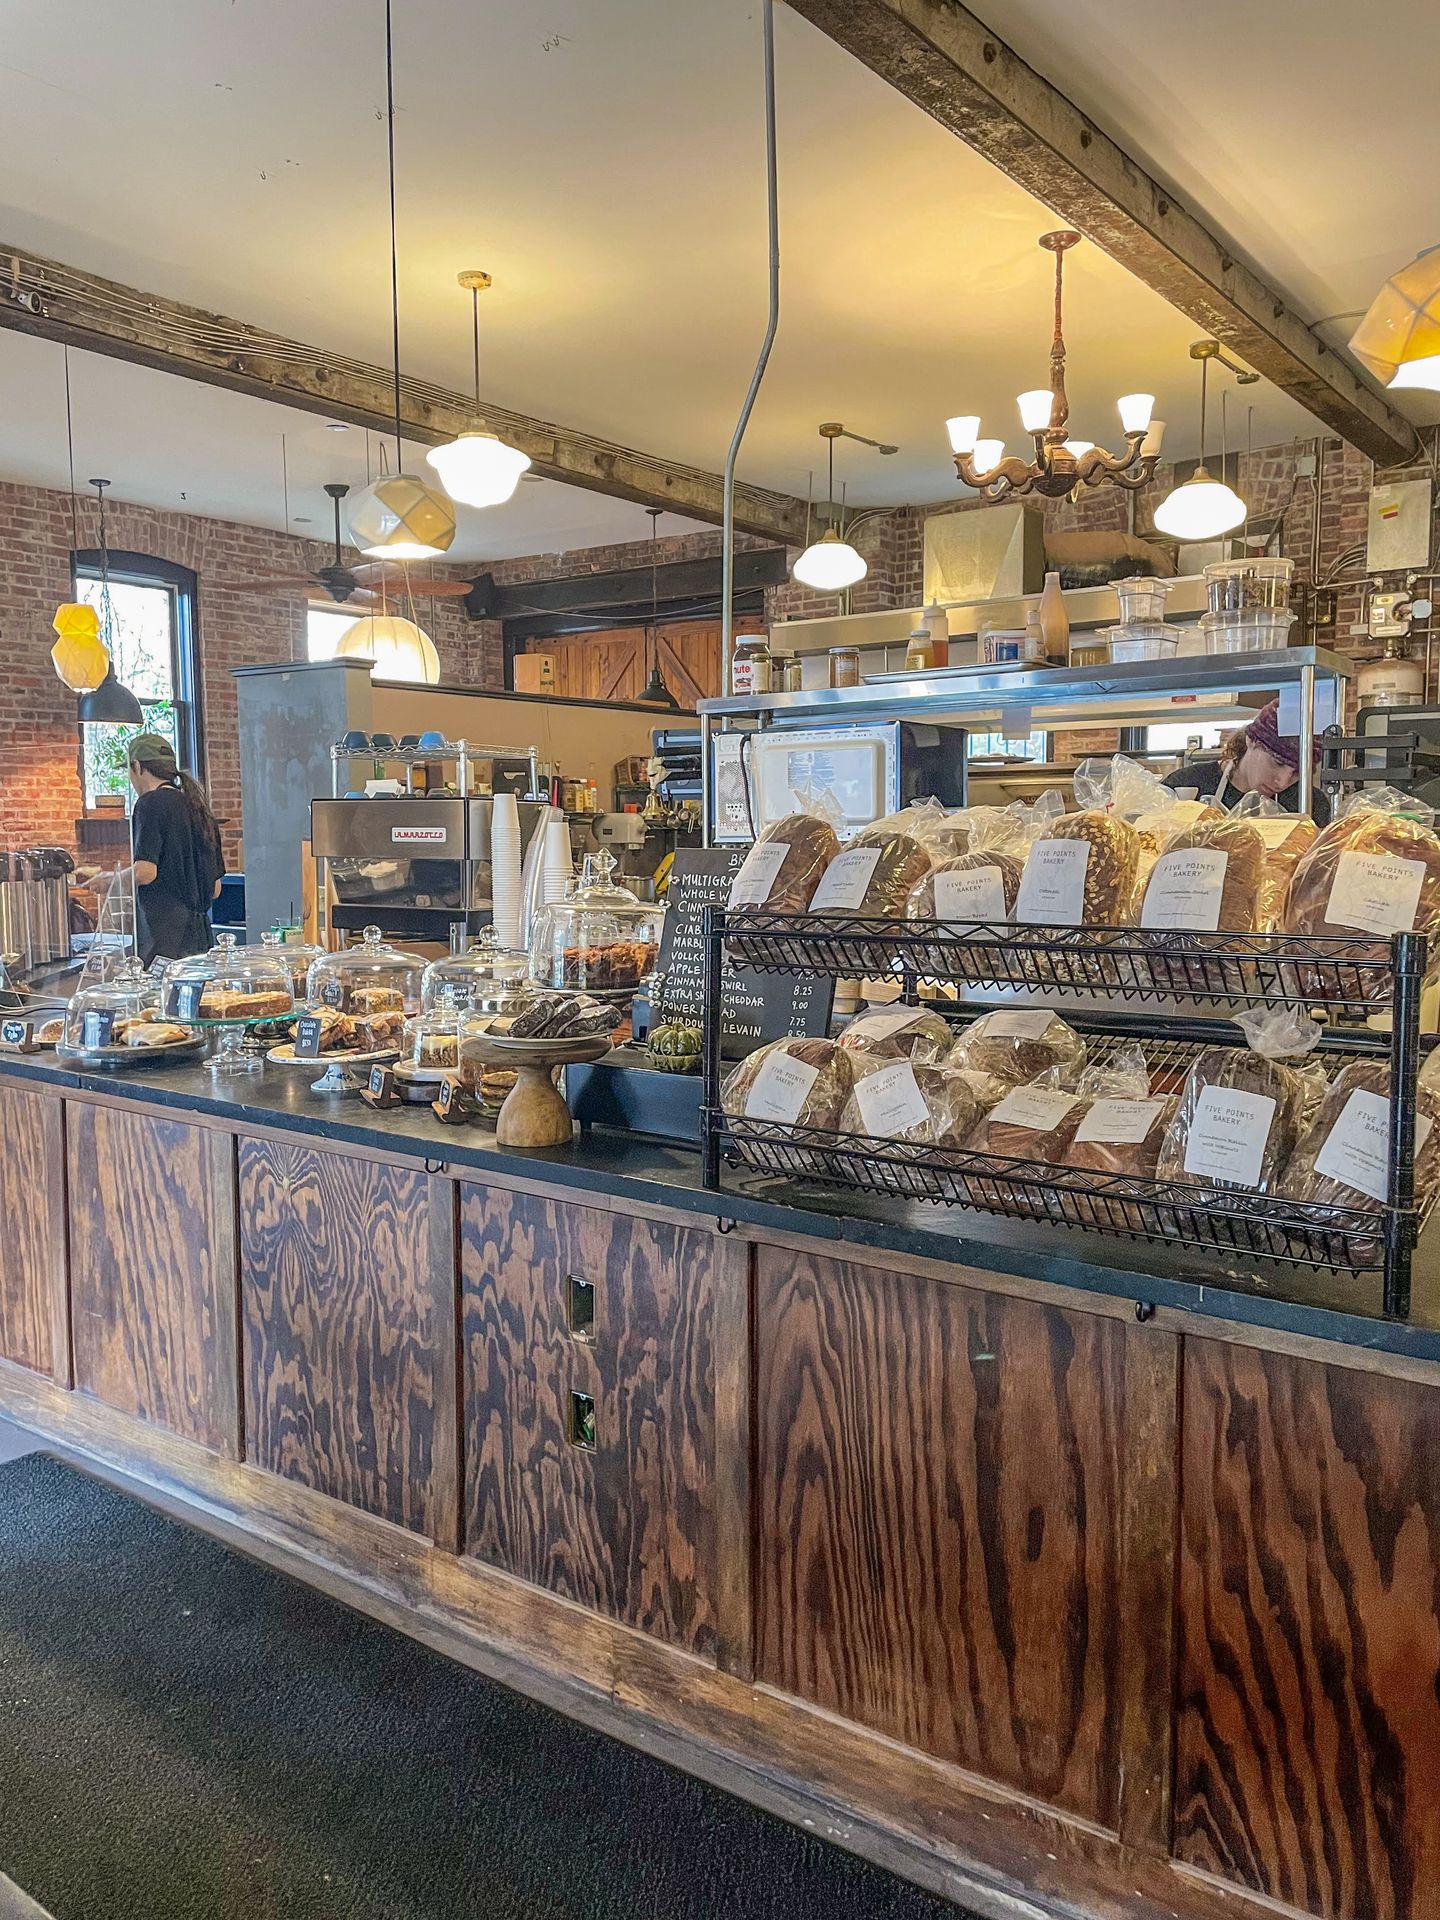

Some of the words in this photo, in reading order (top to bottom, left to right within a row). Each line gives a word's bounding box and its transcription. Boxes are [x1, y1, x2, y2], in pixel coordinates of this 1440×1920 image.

[1037, 850, 1051, 858] FIVE
[1053, 850, 1076, 858] POINTS
[1042, 857, 1065, 865] BAKERY
[1164, 863, 1181, 872] FIVE
[1186, 862, 1215, 872] POINTS
[1356, 861, 1376, 870] FIVE
[1382, 865, 1414, 877] POINTS
[1367, 869, 1399, 881] BAKERY
[682, 873, 734, 887] MULTIGRA
[946, 880, 963, 889] FIVE
[966, 877, 992, 886] POINTS
[680, 888, 716, 900] WHOLE
[957, 884, 982, 894] BAKERY
[675, 923, 702, 935] CIAB
[673, 936, 704, 949] MARBL
[671, 950, 705, 961] VOLLKO
[668, 962, 701, 975] APPLE
[720, 980, 748, 992] SWIRL
[793, 984, 813, 996] 8.25
[663, 987, 693, 1001] EXTRA
[791, 1000, 809, 1011] 9.00
[661, 1000, 698, 1015] POWER
[789, 1016, 806, 1027] 7.75
[660, 1014, 706, 1029] SOURDOU
[722, 1022, 762, 1038] LEVAIN
[771, 1065, 784, 1077] FIVE
[785, 1071, 806, 1085] POINTS
[775, 1074, 795, 1088] BAKERY
[882, 1071, 904, 1086] POINTS
[1205, 1104, 1221, 1114] FIVE
[1226, 1108, 1254, 1120] POINTS
[1358, 1110, 1377, 1123] FIVE
[1213, 1114, 1241, 1125] BAKERY
[1364, 1123, 1389, 1138] BAKER
